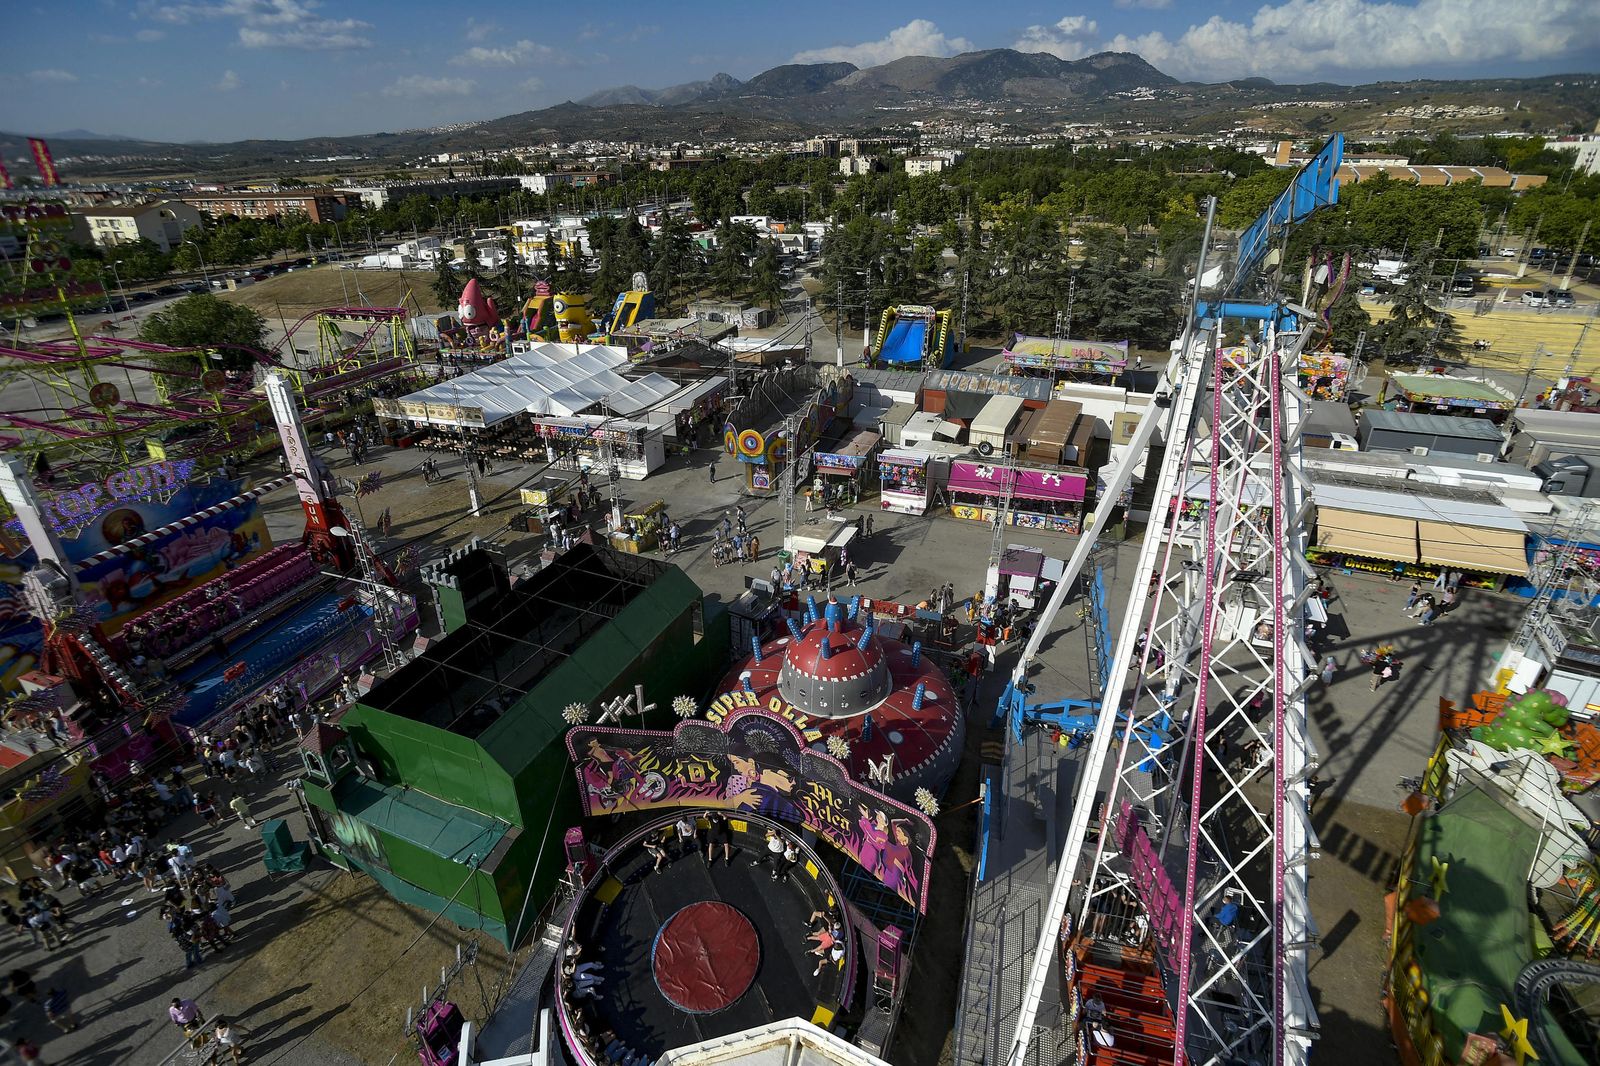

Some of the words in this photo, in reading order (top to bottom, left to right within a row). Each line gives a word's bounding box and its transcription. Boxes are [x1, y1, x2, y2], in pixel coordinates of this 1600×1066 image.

[41, 482, 102, 529] TOP
[105, 460, 176, 499] GUN
[305, 494, 320, 526] GUN
[596, 684, 657, 724] XXL
[706, 690, 761, 725] SUPER
